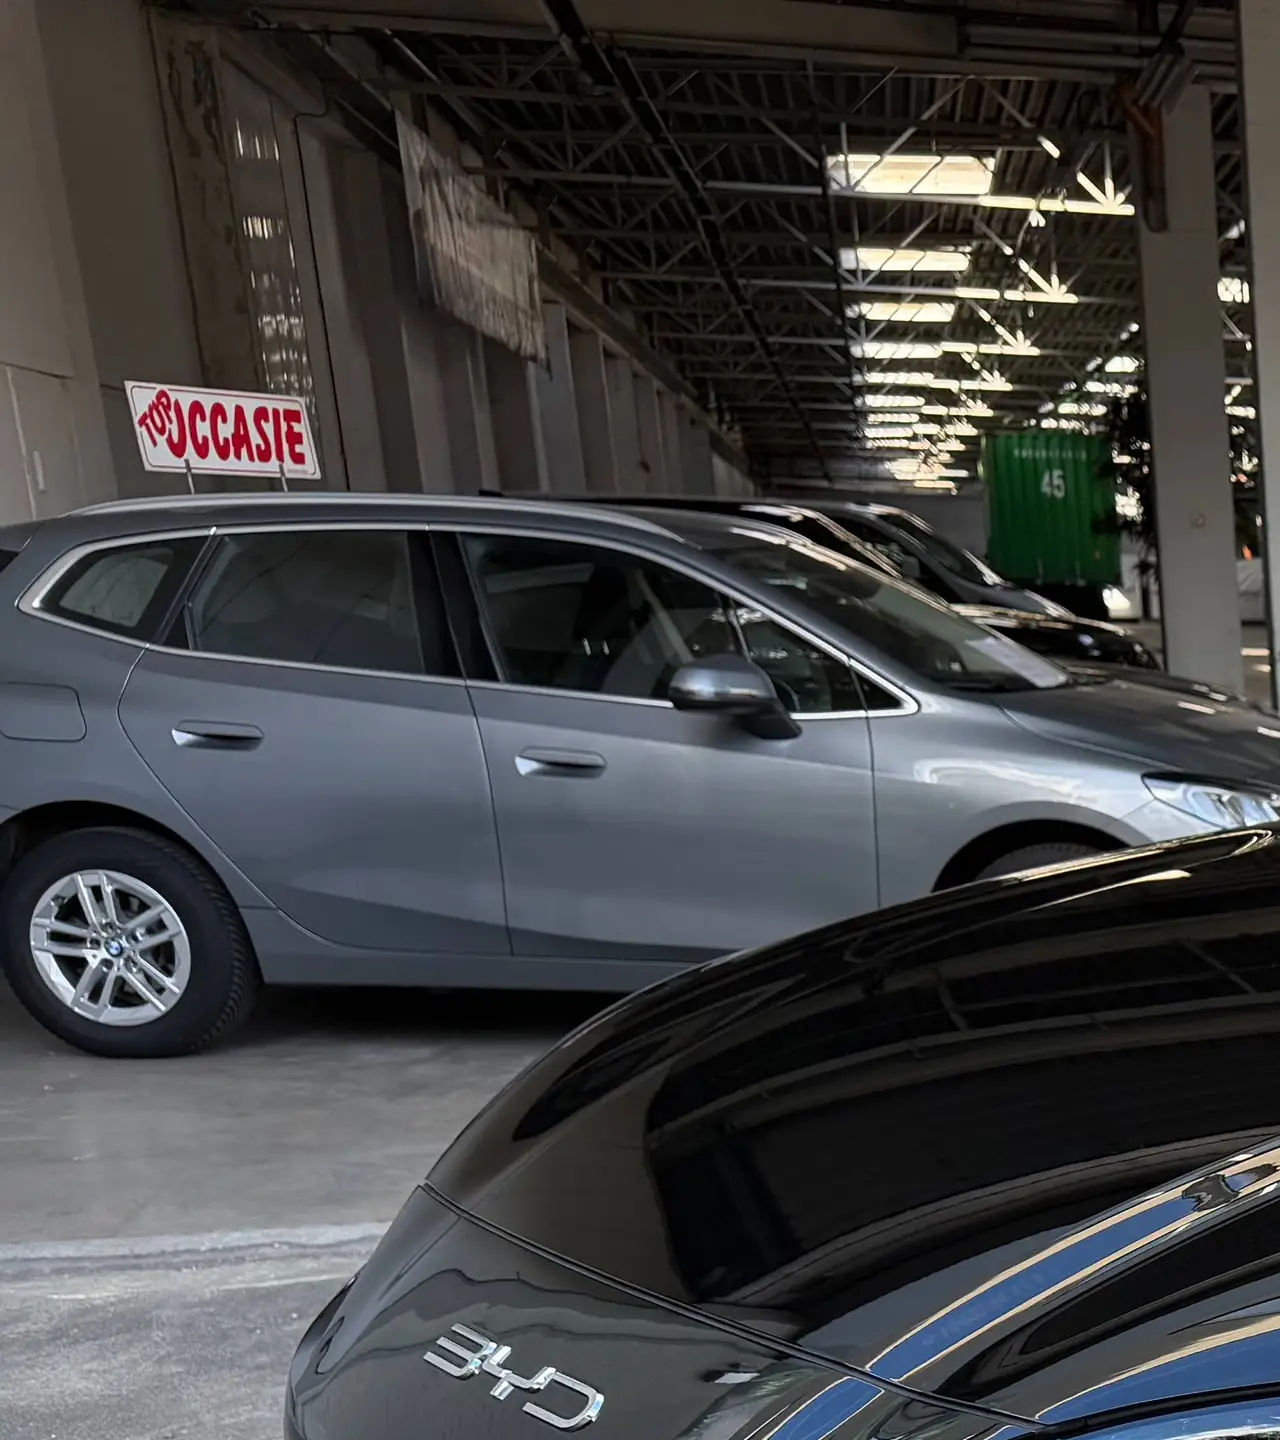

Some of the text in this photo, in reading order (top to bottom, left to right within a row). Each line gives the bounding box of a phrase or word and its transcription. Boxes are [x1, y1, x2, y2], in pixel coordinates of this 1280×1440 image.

[138, 389, 173, 447] TOP
[1040, 468, 1066, 499] 45
[423, 1323, 604, 1429] BYD
